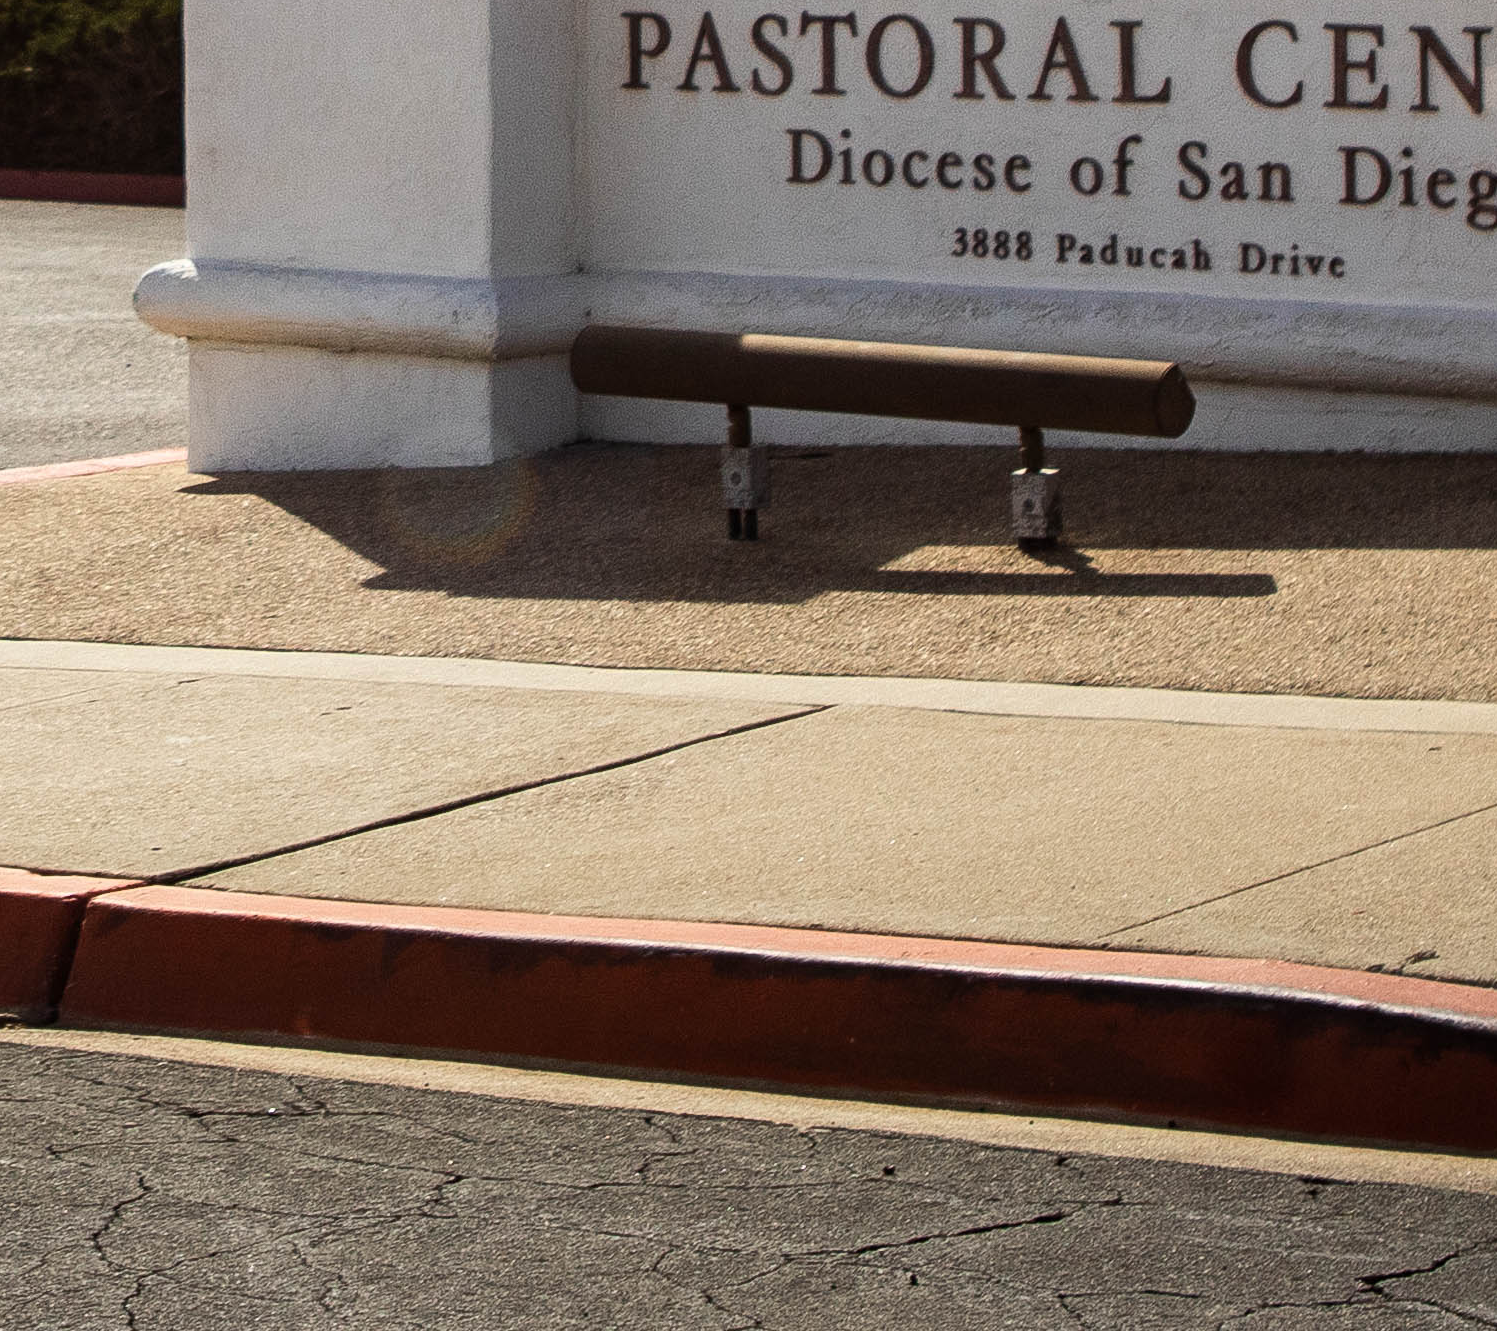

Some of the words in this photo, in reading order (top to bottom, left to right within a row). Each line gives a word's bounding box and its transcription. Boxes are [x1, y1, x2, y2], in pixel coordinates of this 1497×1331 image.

[620, 10, 1172, 105] PASTORAL
[786, 128, 1032, 194] Diocese
[1069, 134, 1143, 197] of
[1177, 140, 1295, 203] San
[952, 227, 1033, 264] 3888
[1056, 232, 1212, 272] Paducah
[1239, 242, 1346, 280] Drive
